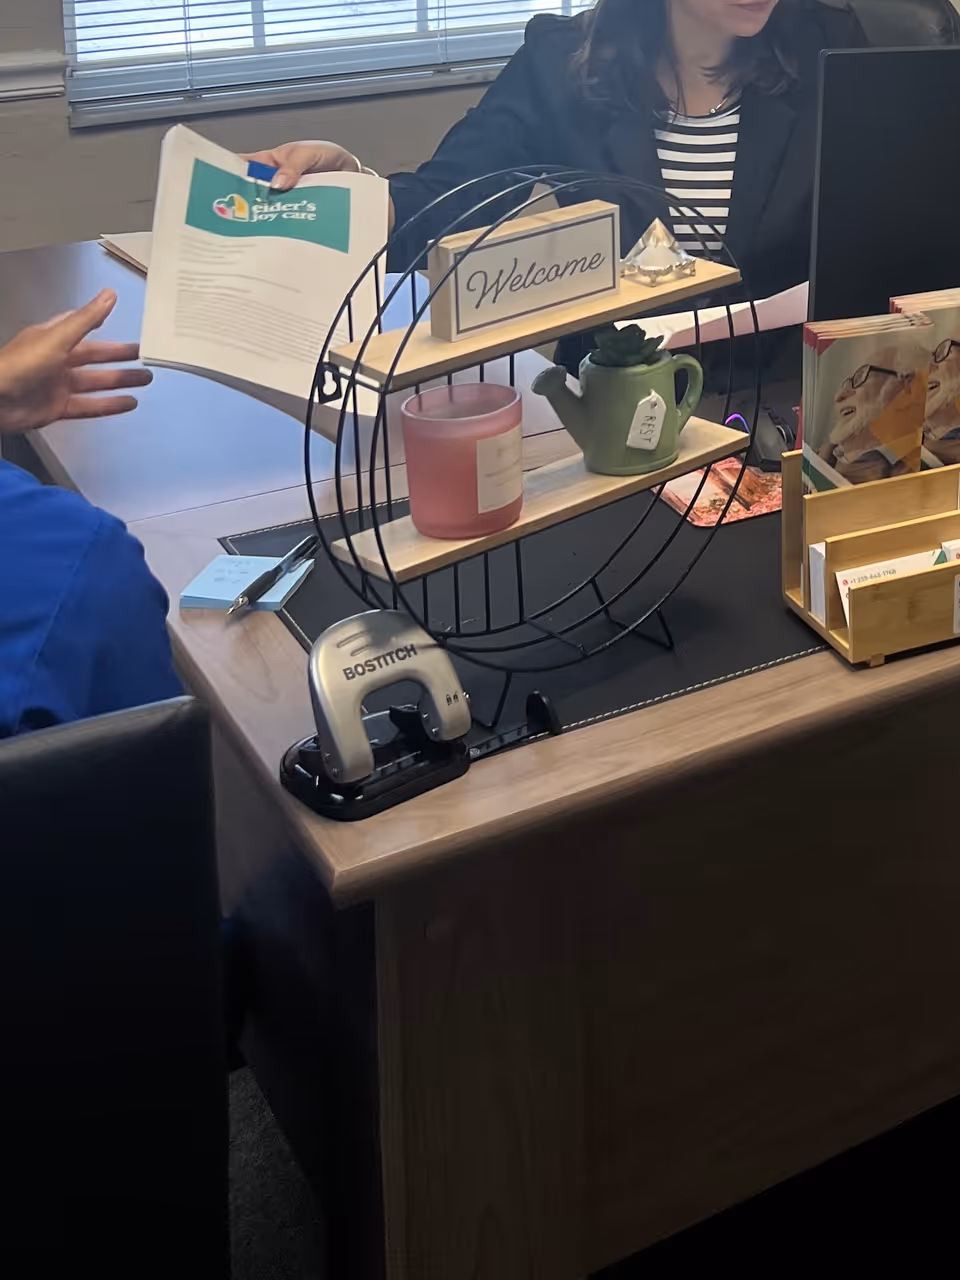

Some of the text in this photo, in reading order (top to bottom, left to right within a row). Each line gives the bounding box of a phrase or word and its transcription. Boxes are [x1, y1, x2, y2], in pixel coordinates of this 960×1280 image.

[282, 211, 317, 221] care
[466, 252, 606, 310] Welcome
[638, 415, 656, 443] REST
[342, 643, 418, 681] BOSTITCH
